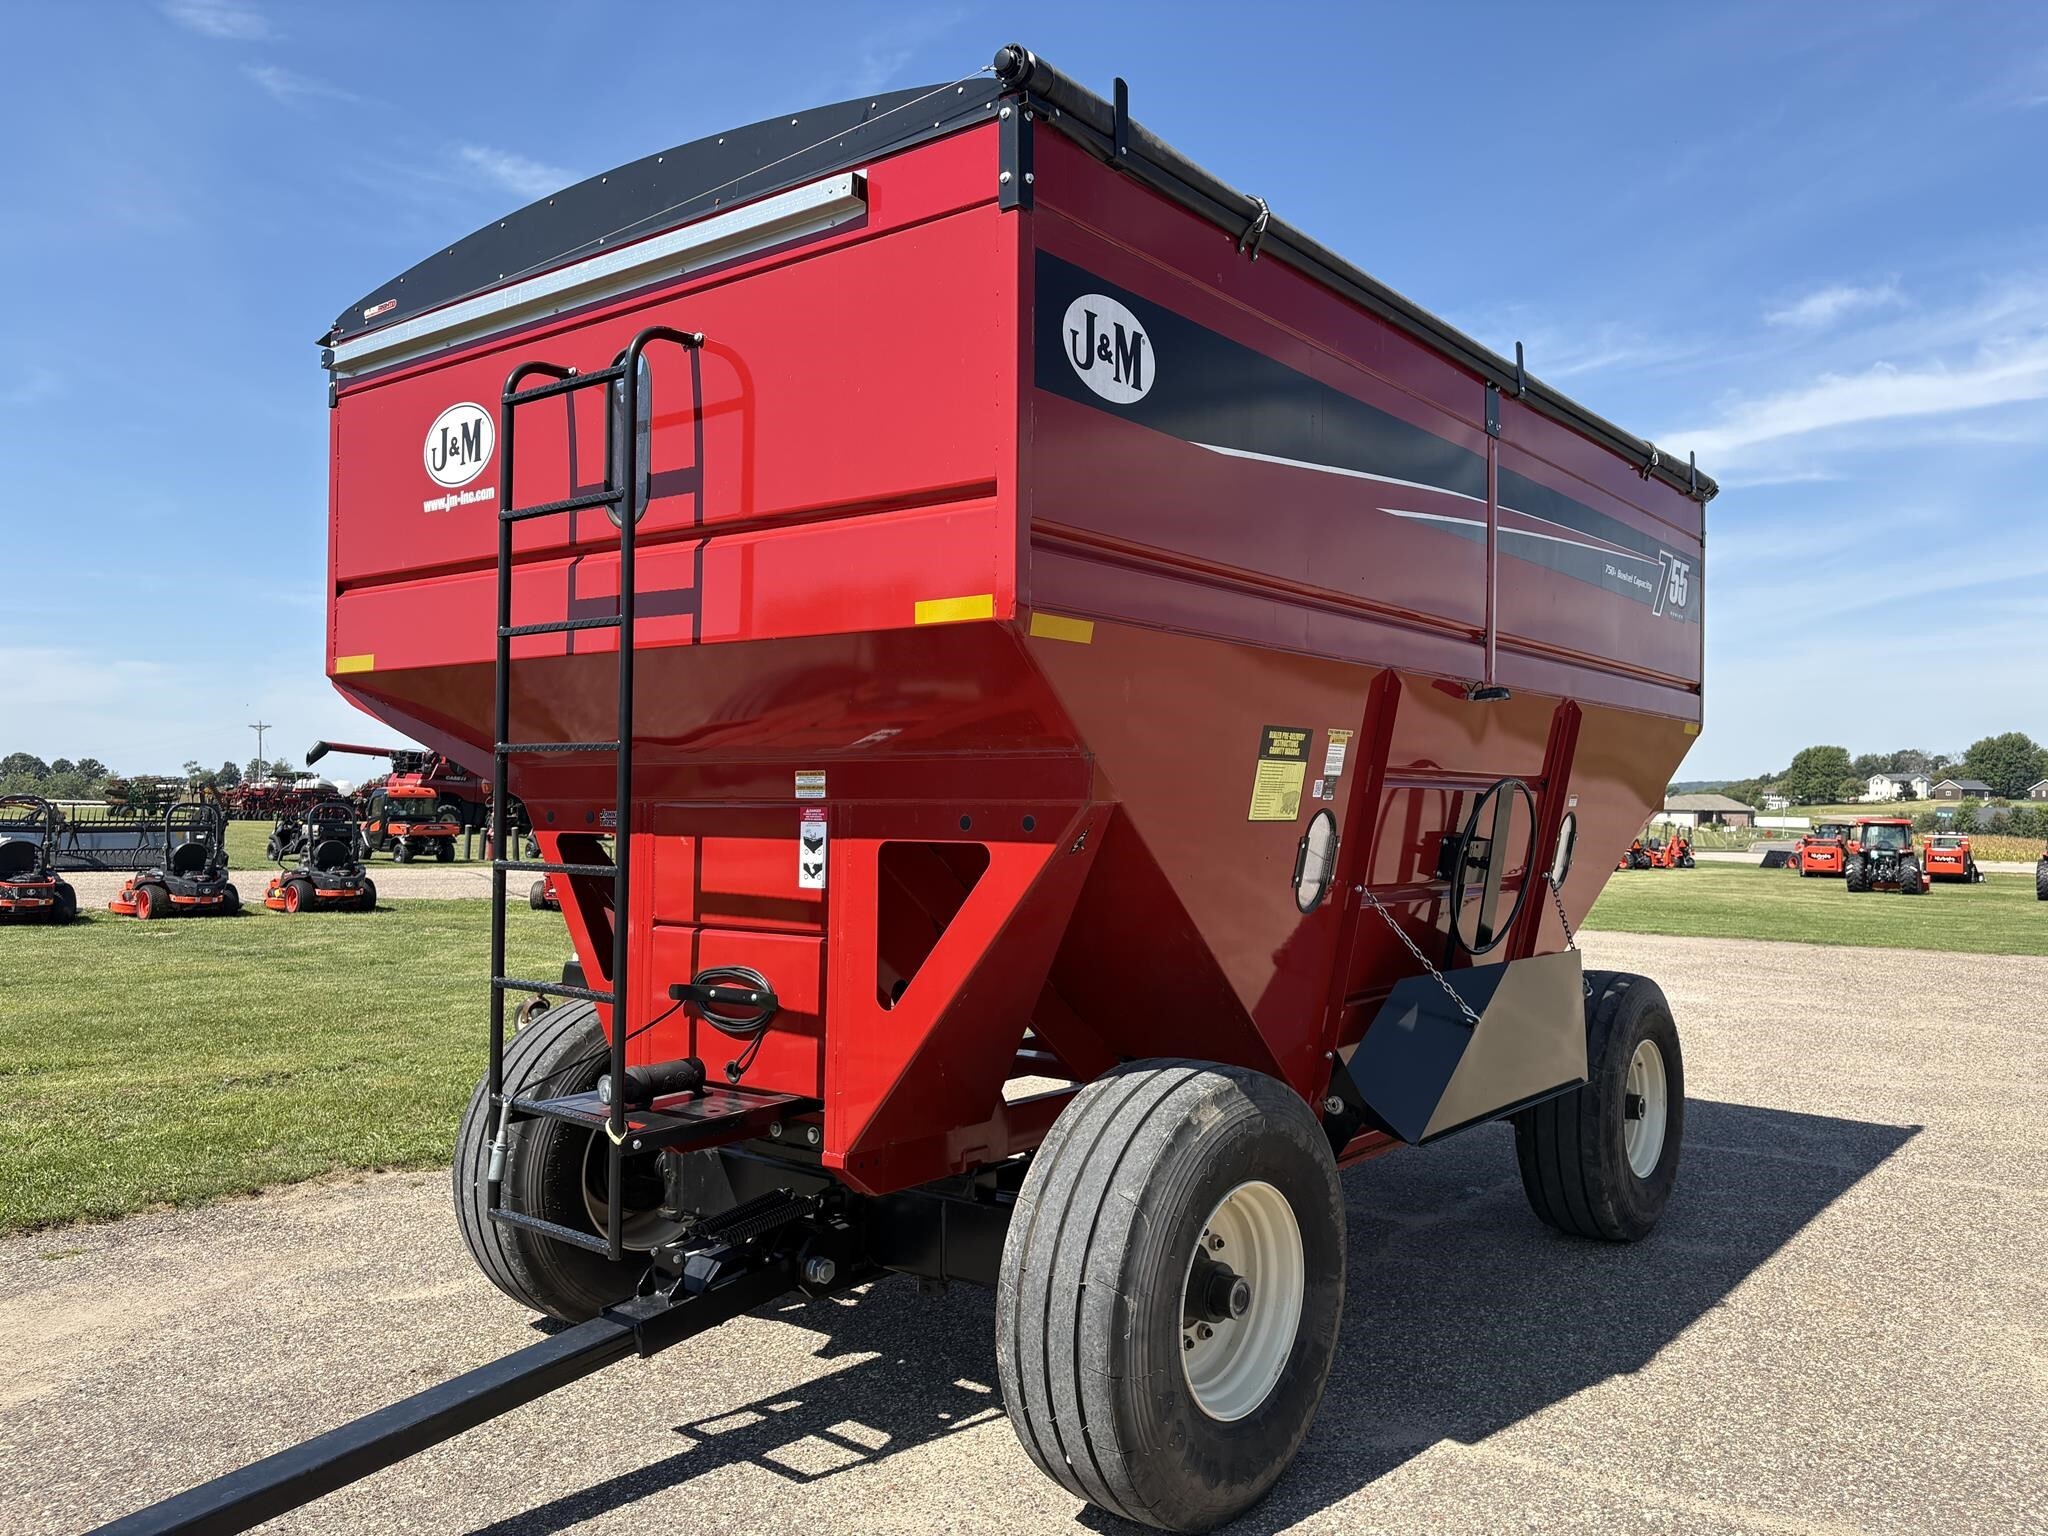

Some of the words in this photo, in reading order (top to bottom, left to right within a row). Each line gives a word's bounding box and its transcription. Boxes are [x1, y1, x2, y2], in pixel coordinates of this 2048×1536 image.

[1070, 309, 1143, 391] J&M
[432, 418, 483, 472] J&M
[423, 487, 495, 512] www.jm-inc.com
[1617, 569, 1634, 583] Bushel
[1633, 575, 1653, 593] Capacity
[1652, 549, 1690, 617] 755
[1268, 746, 1285, 755] GRAVITY
